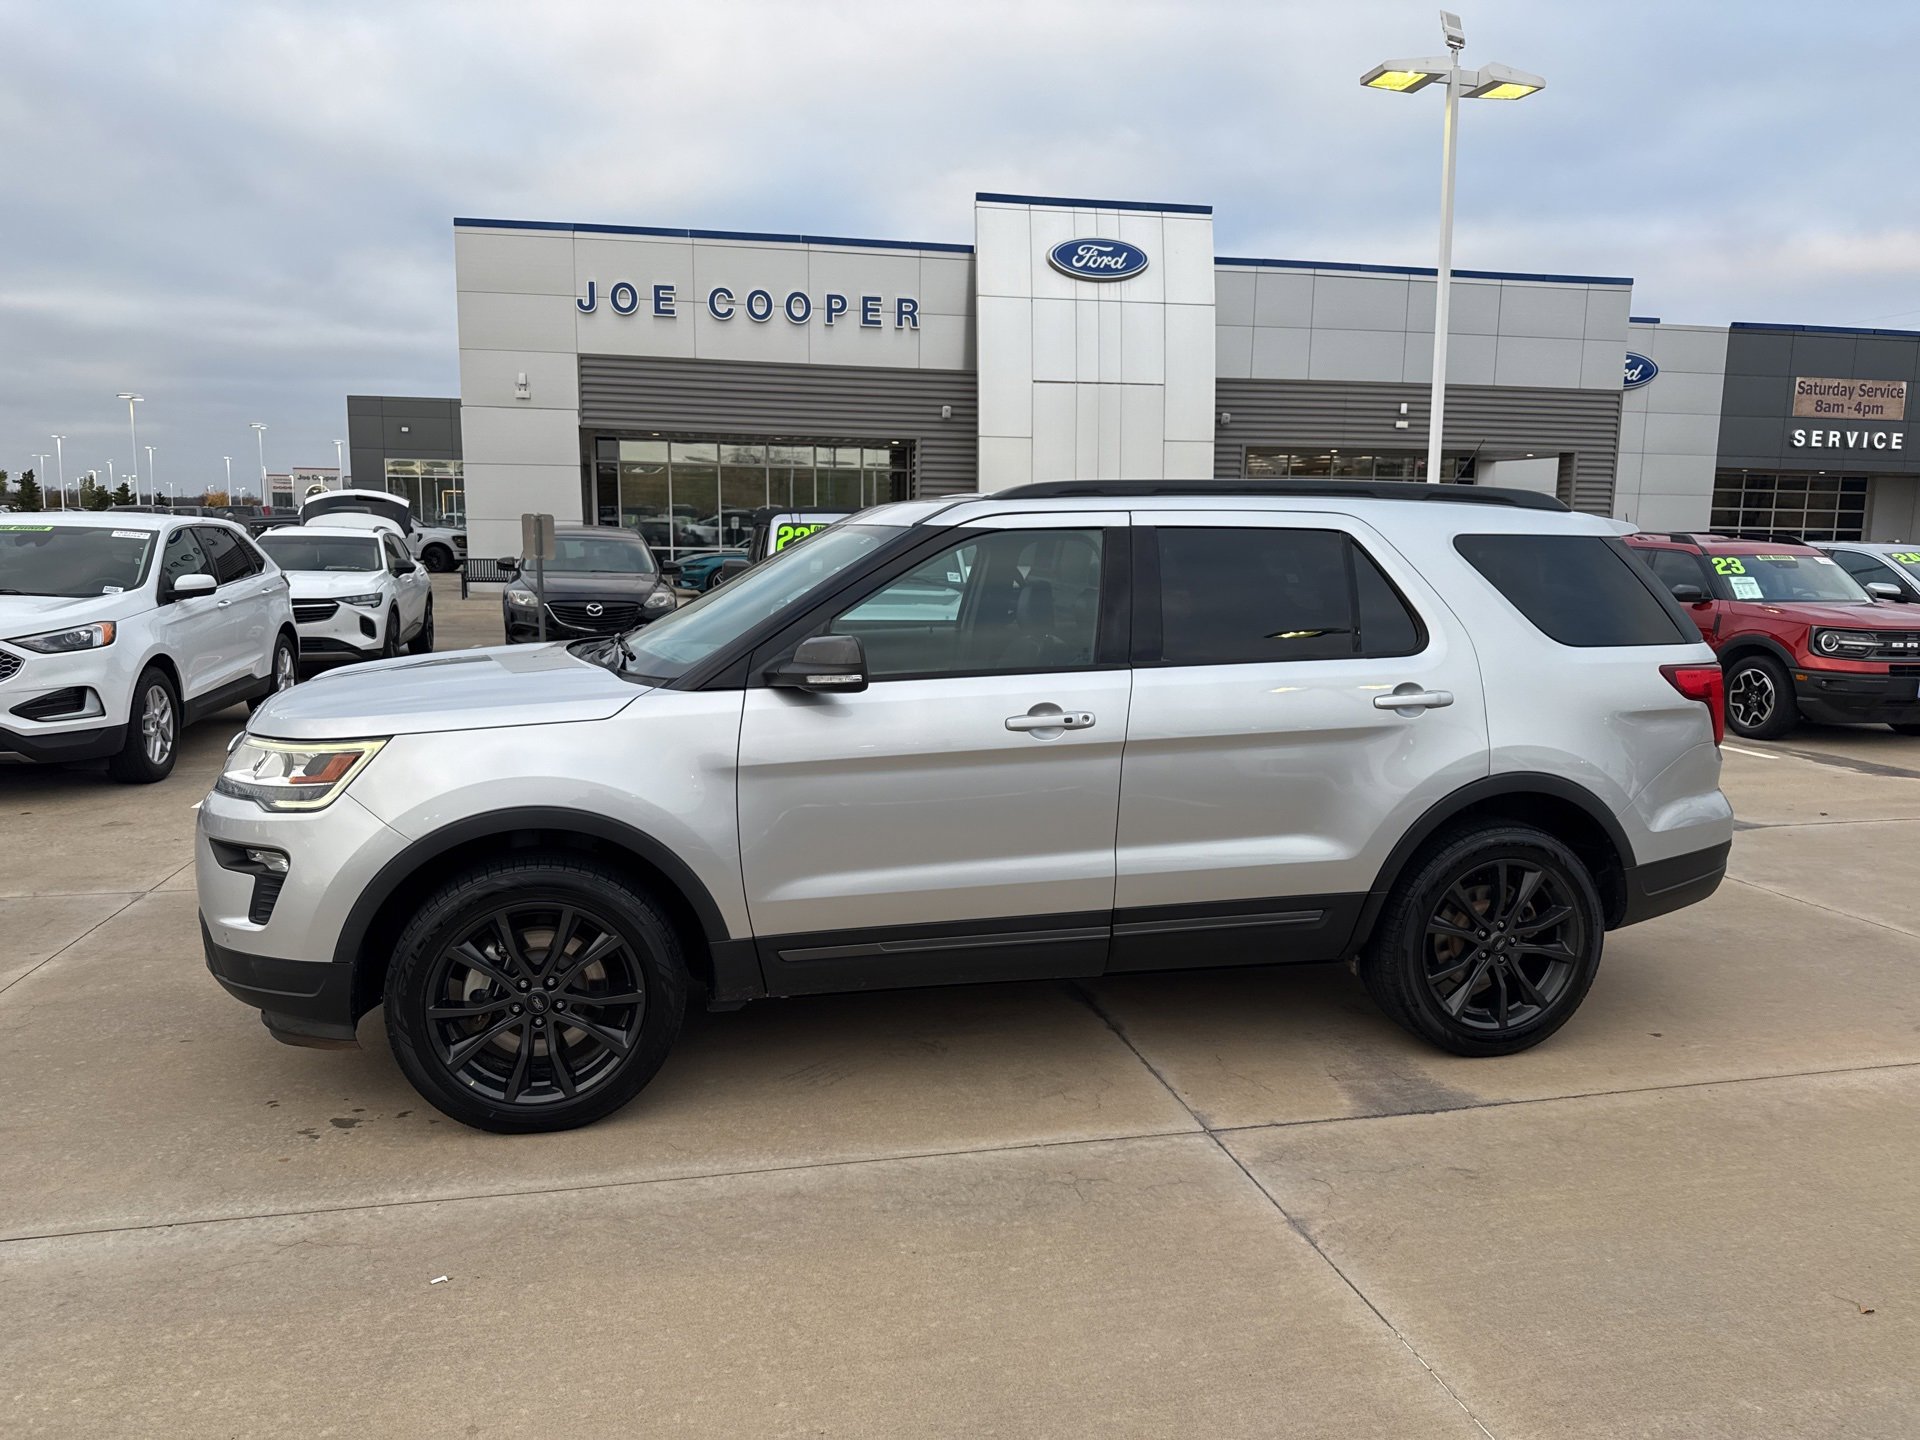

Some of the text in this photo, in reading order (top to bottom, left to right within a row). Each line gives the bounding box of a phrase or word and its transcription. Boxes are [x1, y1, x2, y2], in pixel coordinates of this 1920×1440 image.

[1072, 244, 1128, 269] Ford
[576, 280, 920, 330] JOE COOPER
[1797, 380, 1905, 400] Saturday Service
[1814, 400, 1845, 414] 8am
[1853, 401, 1884, 417] 4pm
[1793, 429, 1904, 450] SERVICE
[1711, 557, 1746, 575] 23
